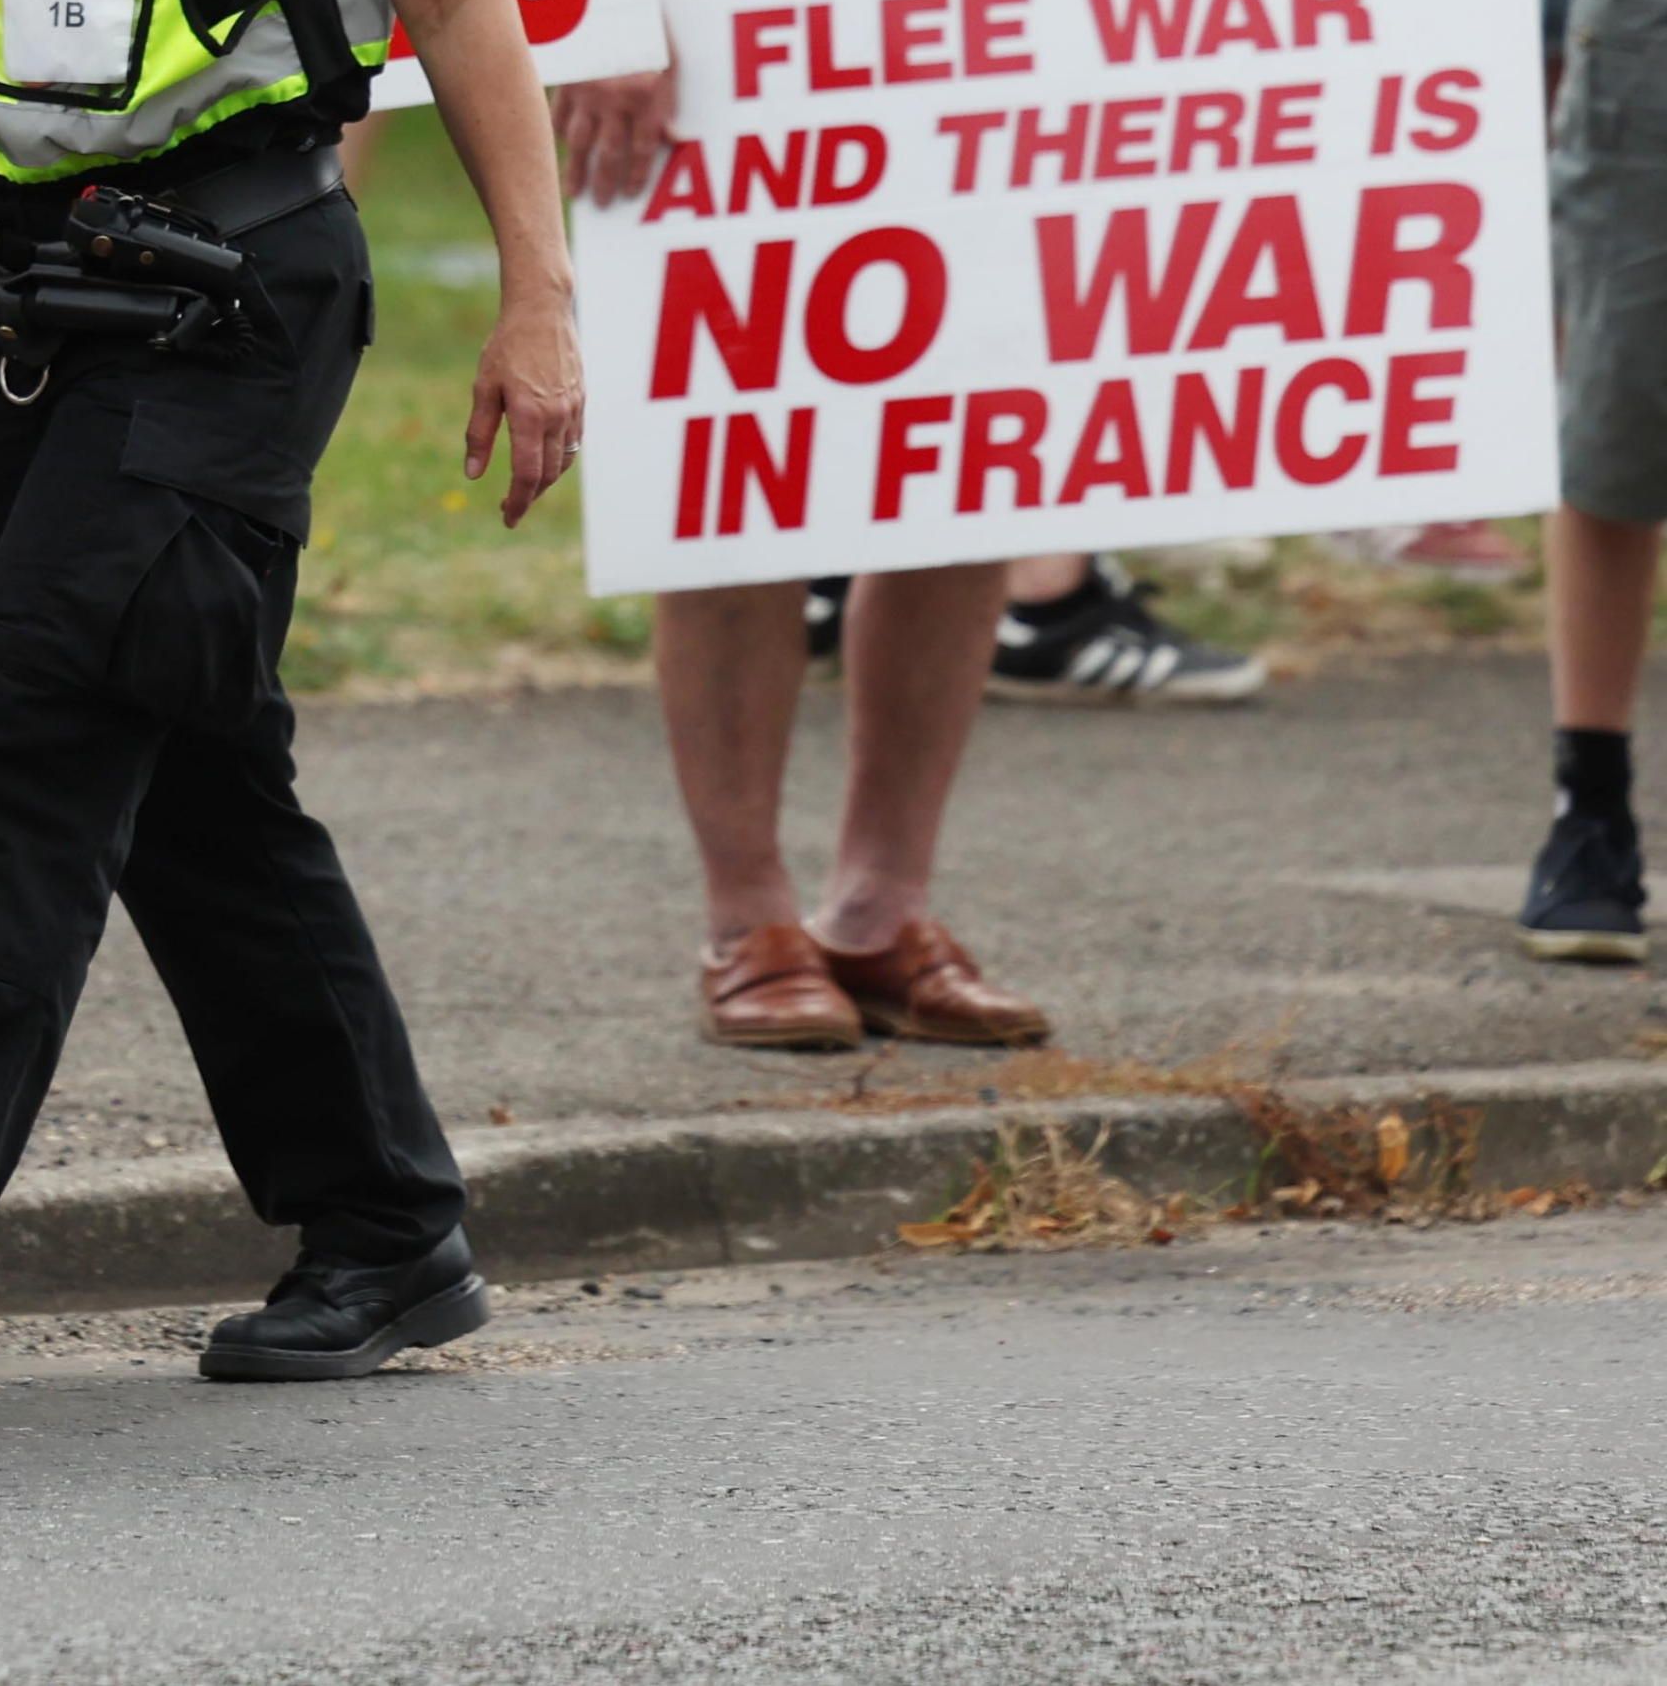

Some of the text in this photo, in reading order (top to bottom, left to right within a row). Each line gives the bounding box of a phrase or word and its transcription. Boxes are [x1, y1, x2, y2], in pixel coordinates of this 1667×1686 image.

[48, 0, 86, 28] 1B
[643, 68, 1482, 223] AND THERE IS
[648, 181, 1483, 401] NO WAR
[673, 349, 1467, 540] IN FRANCE
